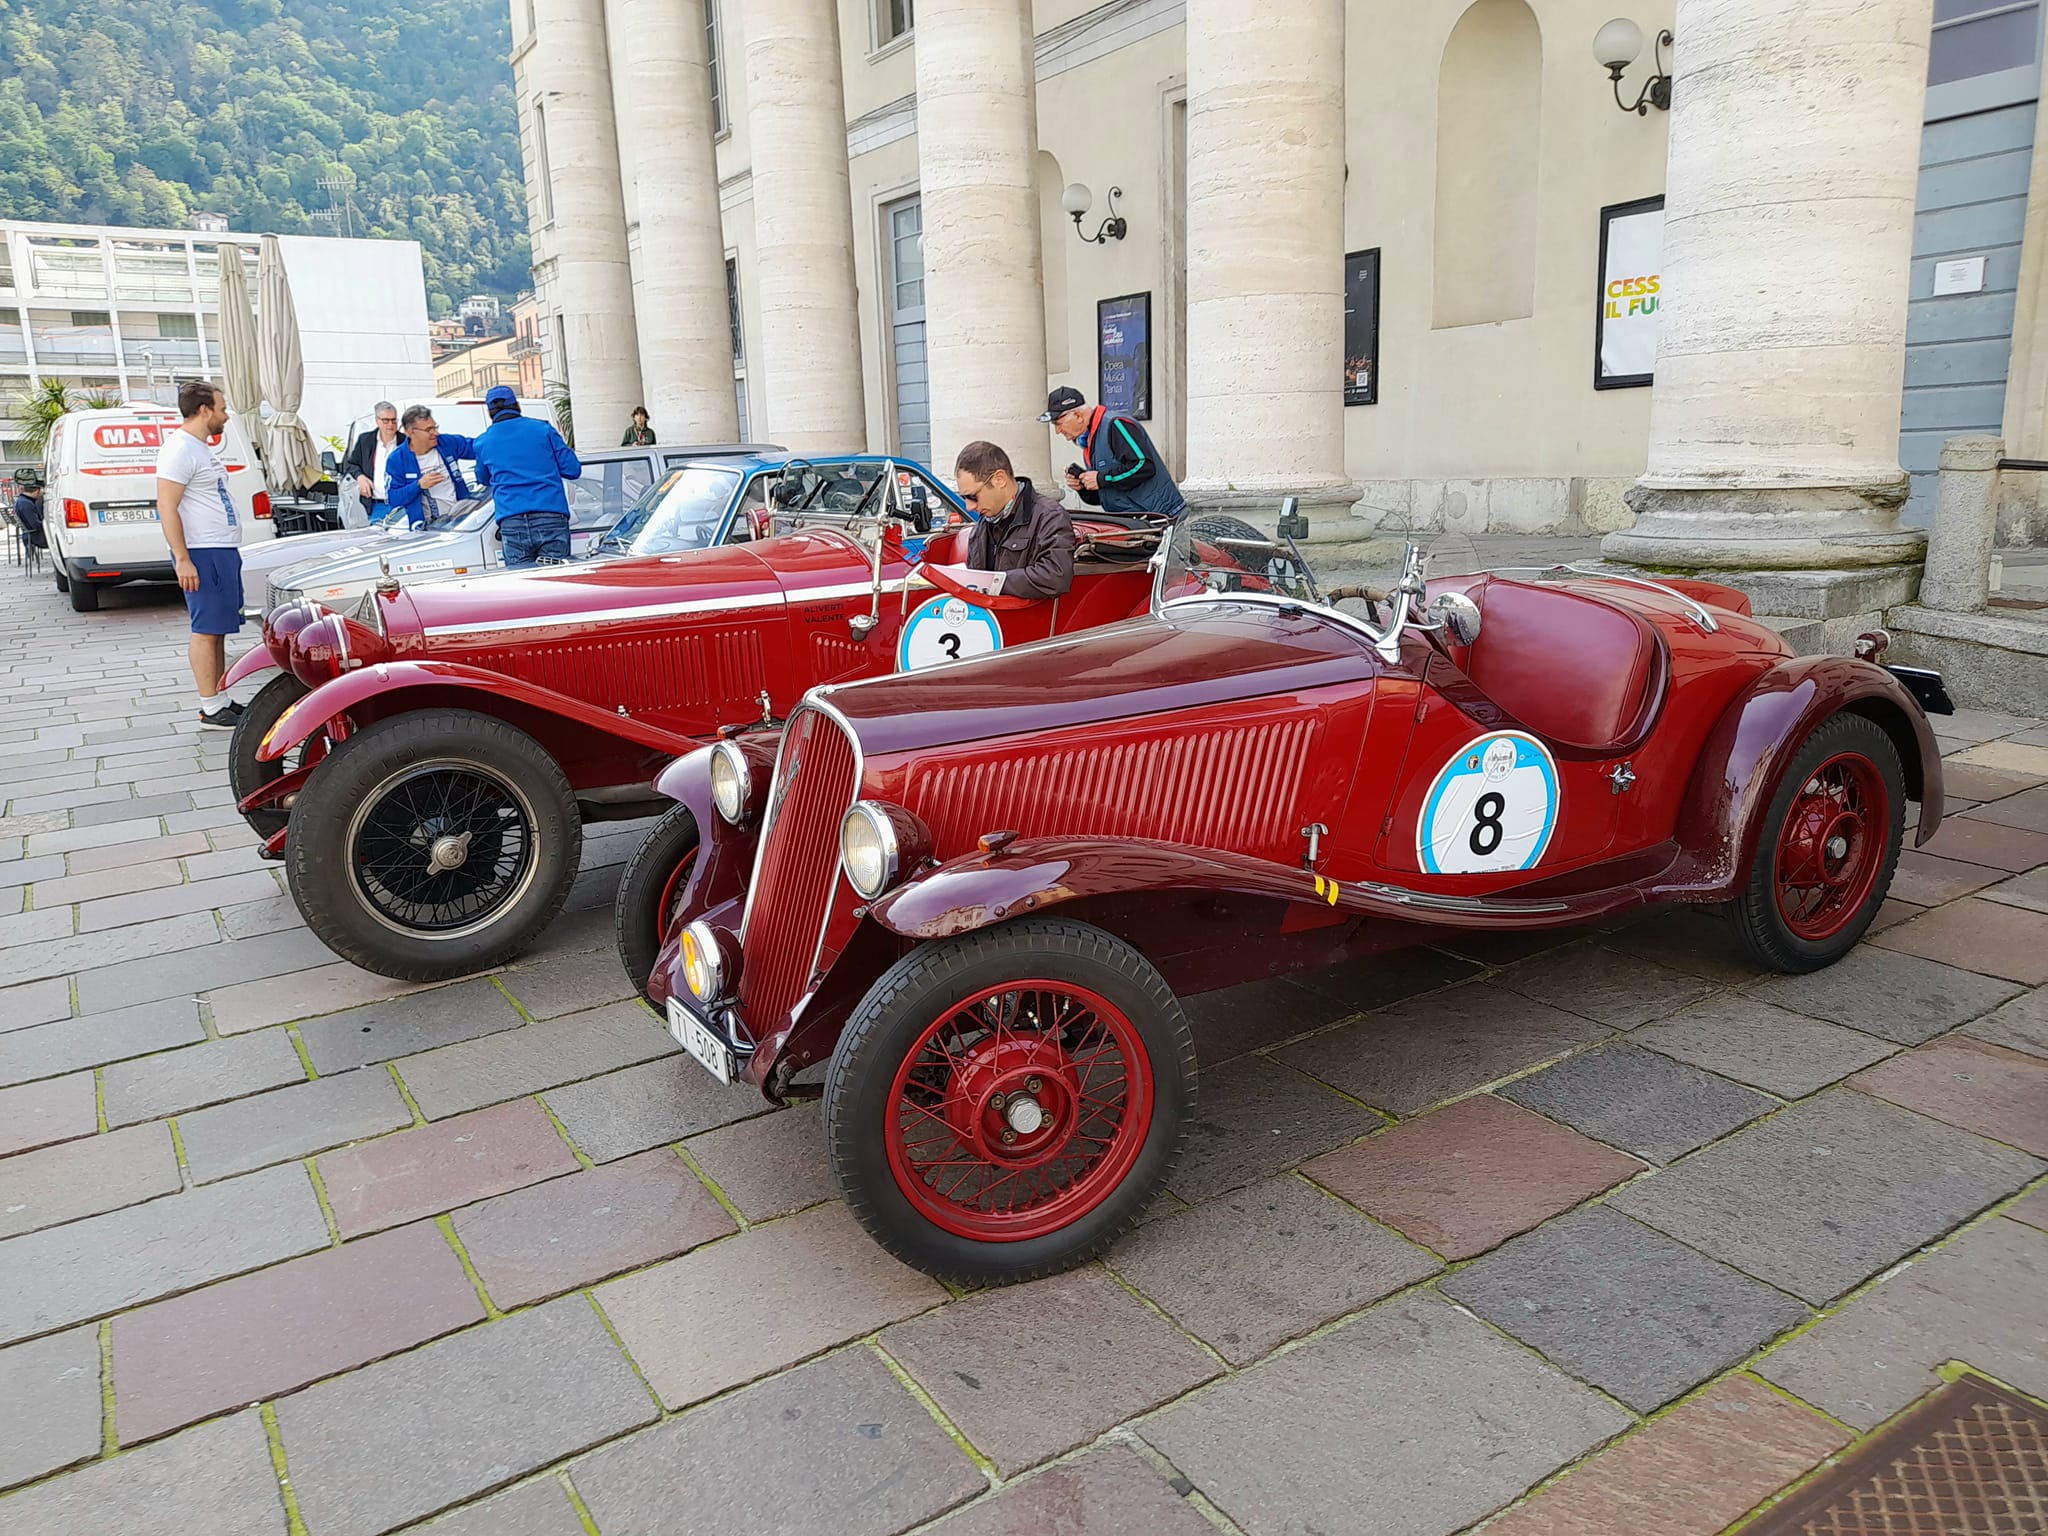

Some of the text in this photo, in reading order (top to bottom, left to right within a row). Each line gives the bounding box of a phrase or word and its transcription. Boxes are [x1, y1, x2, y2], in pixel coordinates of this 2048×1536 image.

[1607, 275, 1661, 298] CESS
[1605, 296, 1661, 319] IL FU
[1103, 360, 1124, 372] Opera
[804, 603, 844, 613] ALIVERTI
[804, 613, 845, 624] VALENTE
[938, 633, 961, 660] 3
[1469, 791, 1506, 856] 8
